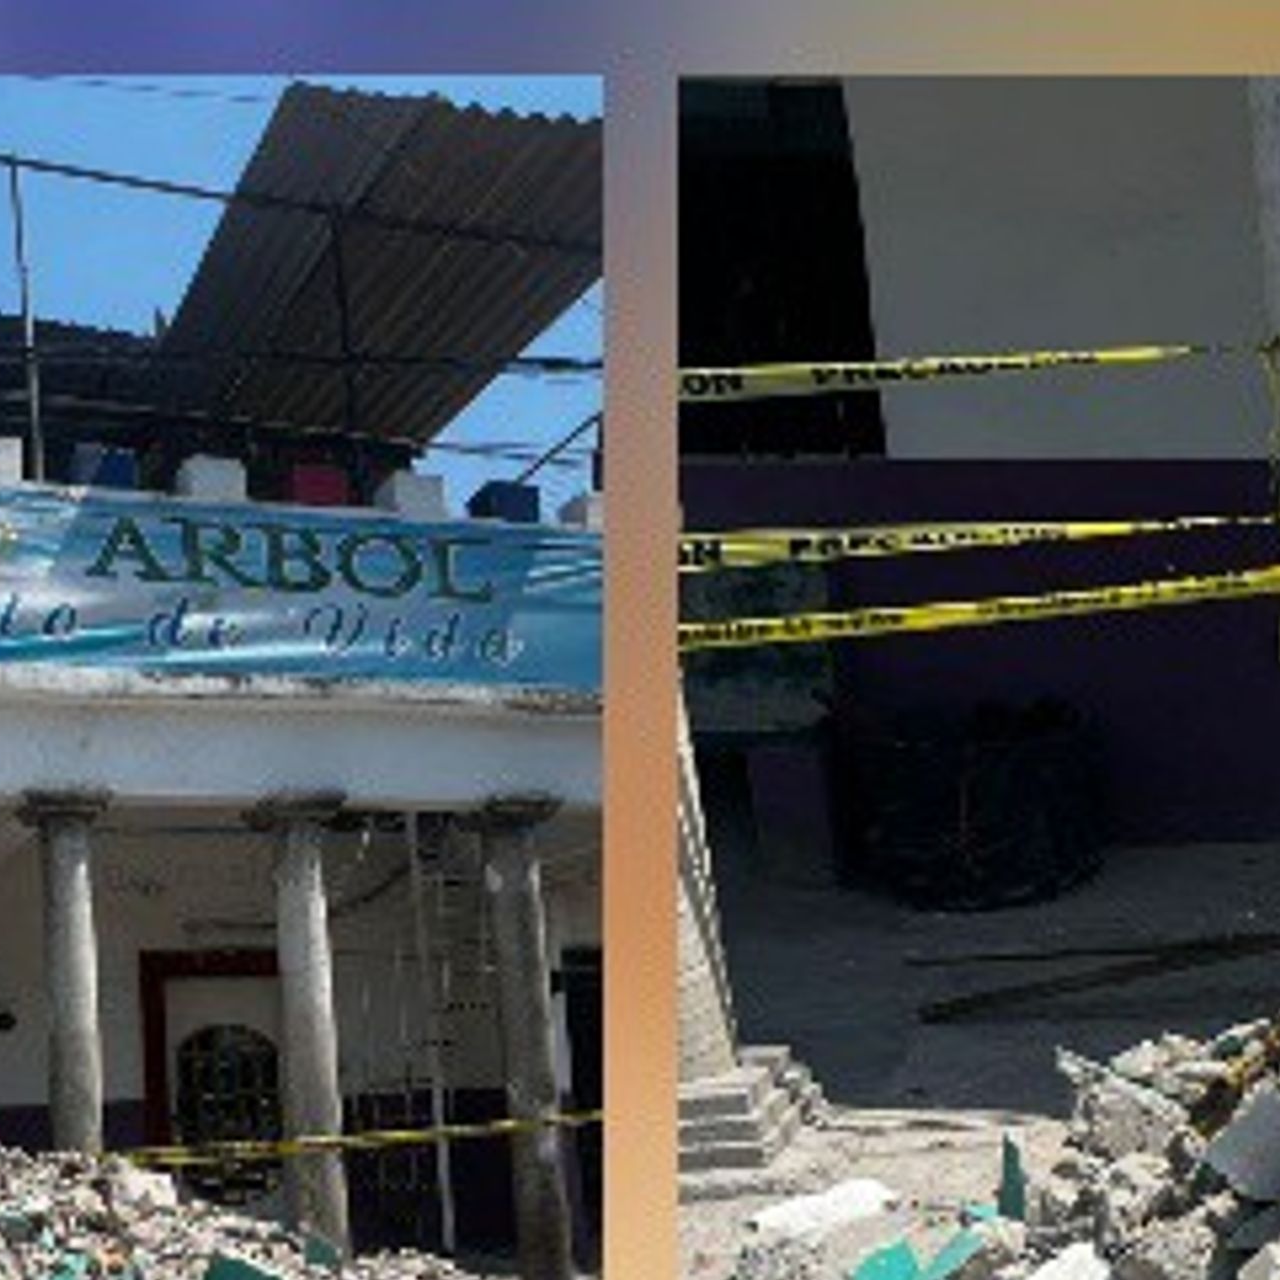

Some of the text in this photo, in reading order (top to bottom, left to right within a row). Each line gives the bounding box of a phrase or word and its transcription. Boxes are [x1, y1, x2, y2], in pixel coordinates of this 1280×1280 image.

[87, 517, 493, 600] ARBOL
[149, 600, 245, 652] de
[303, 604, 524, 667] Vida
